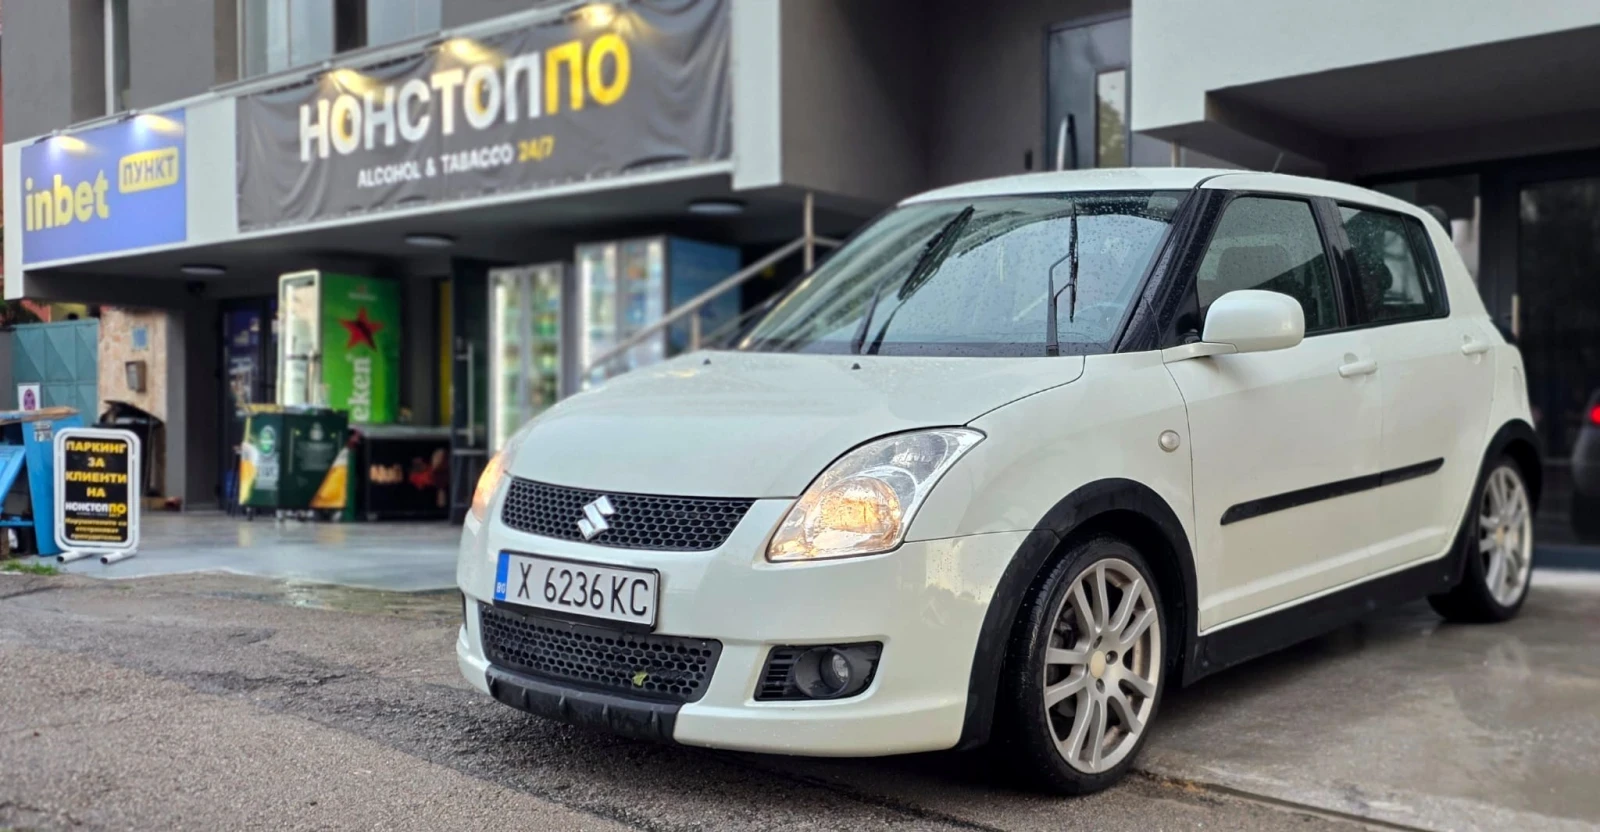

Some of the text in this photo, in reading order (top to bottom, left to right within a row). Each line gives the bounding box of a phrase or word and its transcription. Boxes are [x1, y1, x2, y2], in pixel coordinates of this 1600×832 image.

[299, 34, 631, 162] НОНСТОППО
[122, 154, 176, 186] ПУНКТ
[357, 136, 555, 188] ALCOHOL & TABACCO 24/7
[25, 169, 110, 232] inbet
[65, 440, 127, 454] ПАРКИНГ
[87, 456, 105, 468] ЗА
[65, 471, 127, 484] КЛИЕНТИ
[86, 487, 106, 498] НА
[544, 567, 604, 610] 6236
